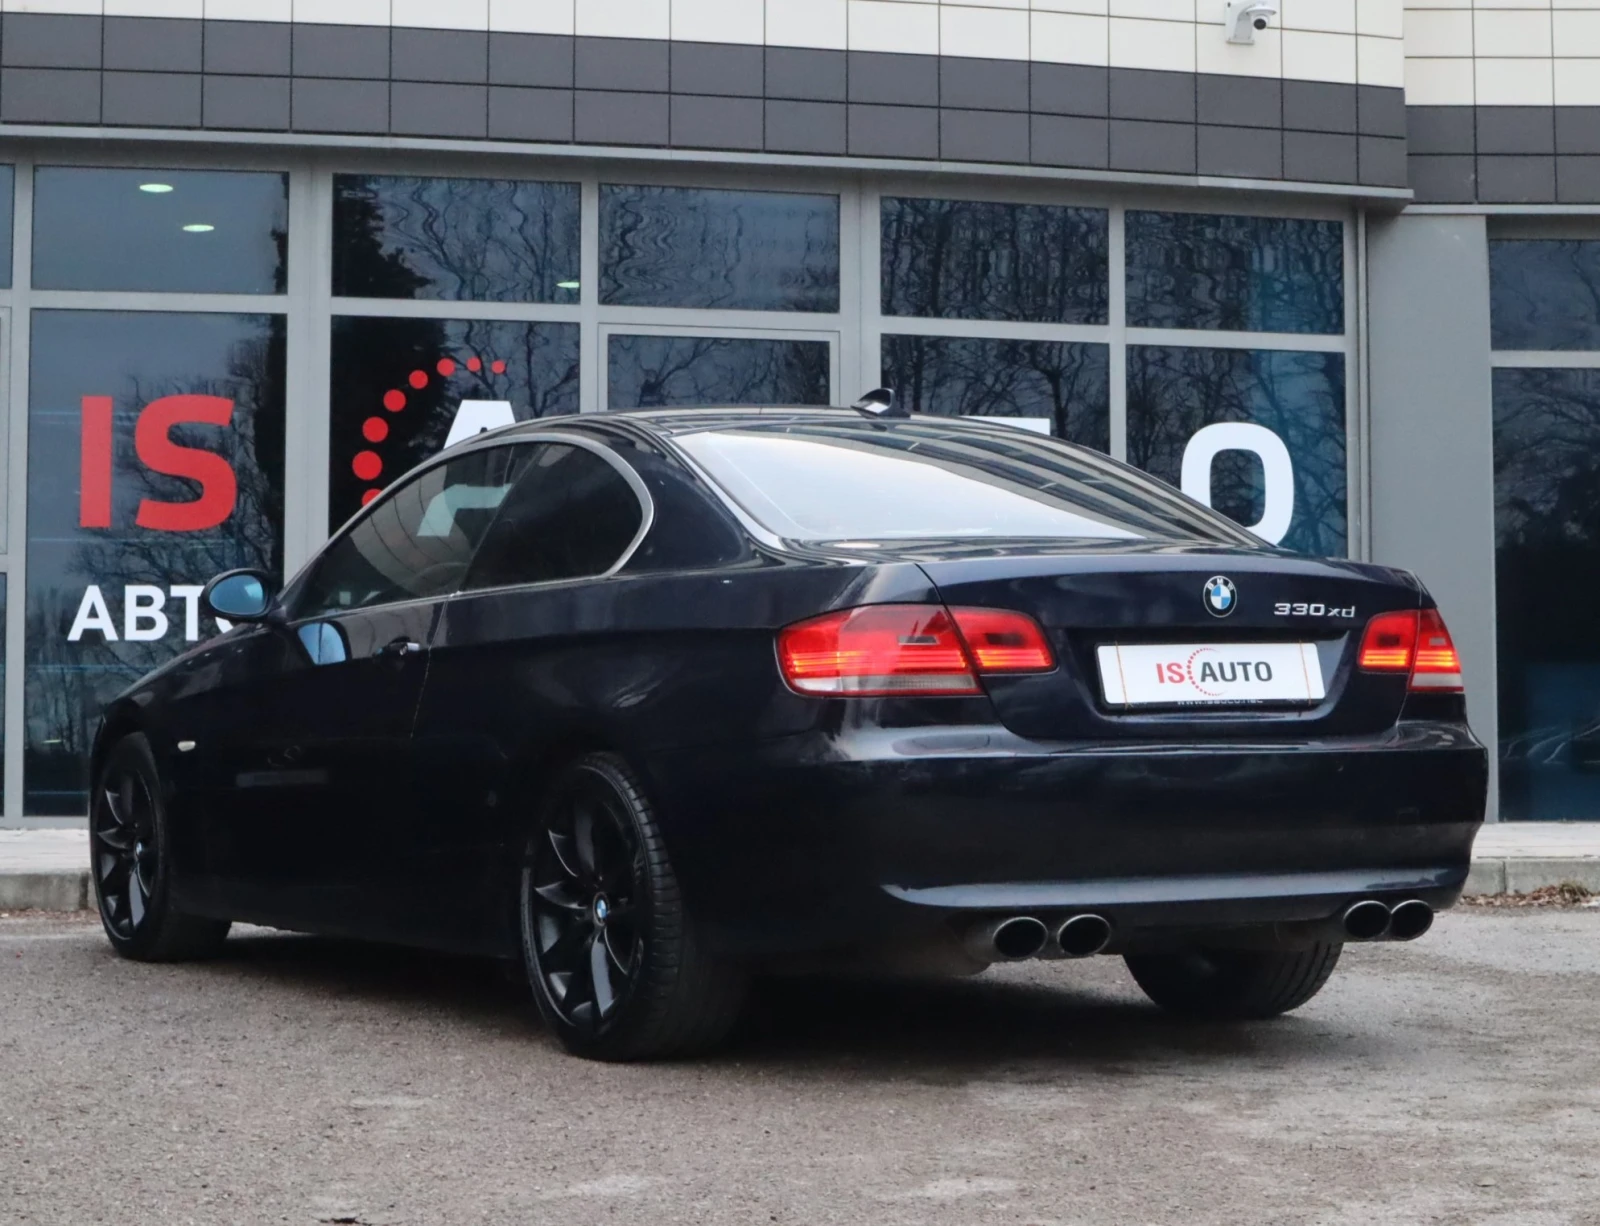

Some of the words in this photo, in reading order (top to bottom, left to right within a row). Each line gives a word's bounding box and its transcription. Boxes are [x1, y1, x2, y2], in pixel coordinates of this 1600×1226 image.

[80, 394, 236, 531] IS
[67, 585, 233, 641] АВТ
[1274, 603, 1355, 617] 330xd
[1156, 662, 1184, 683] IS
[1200, 661, 1272, 682] AUTO
